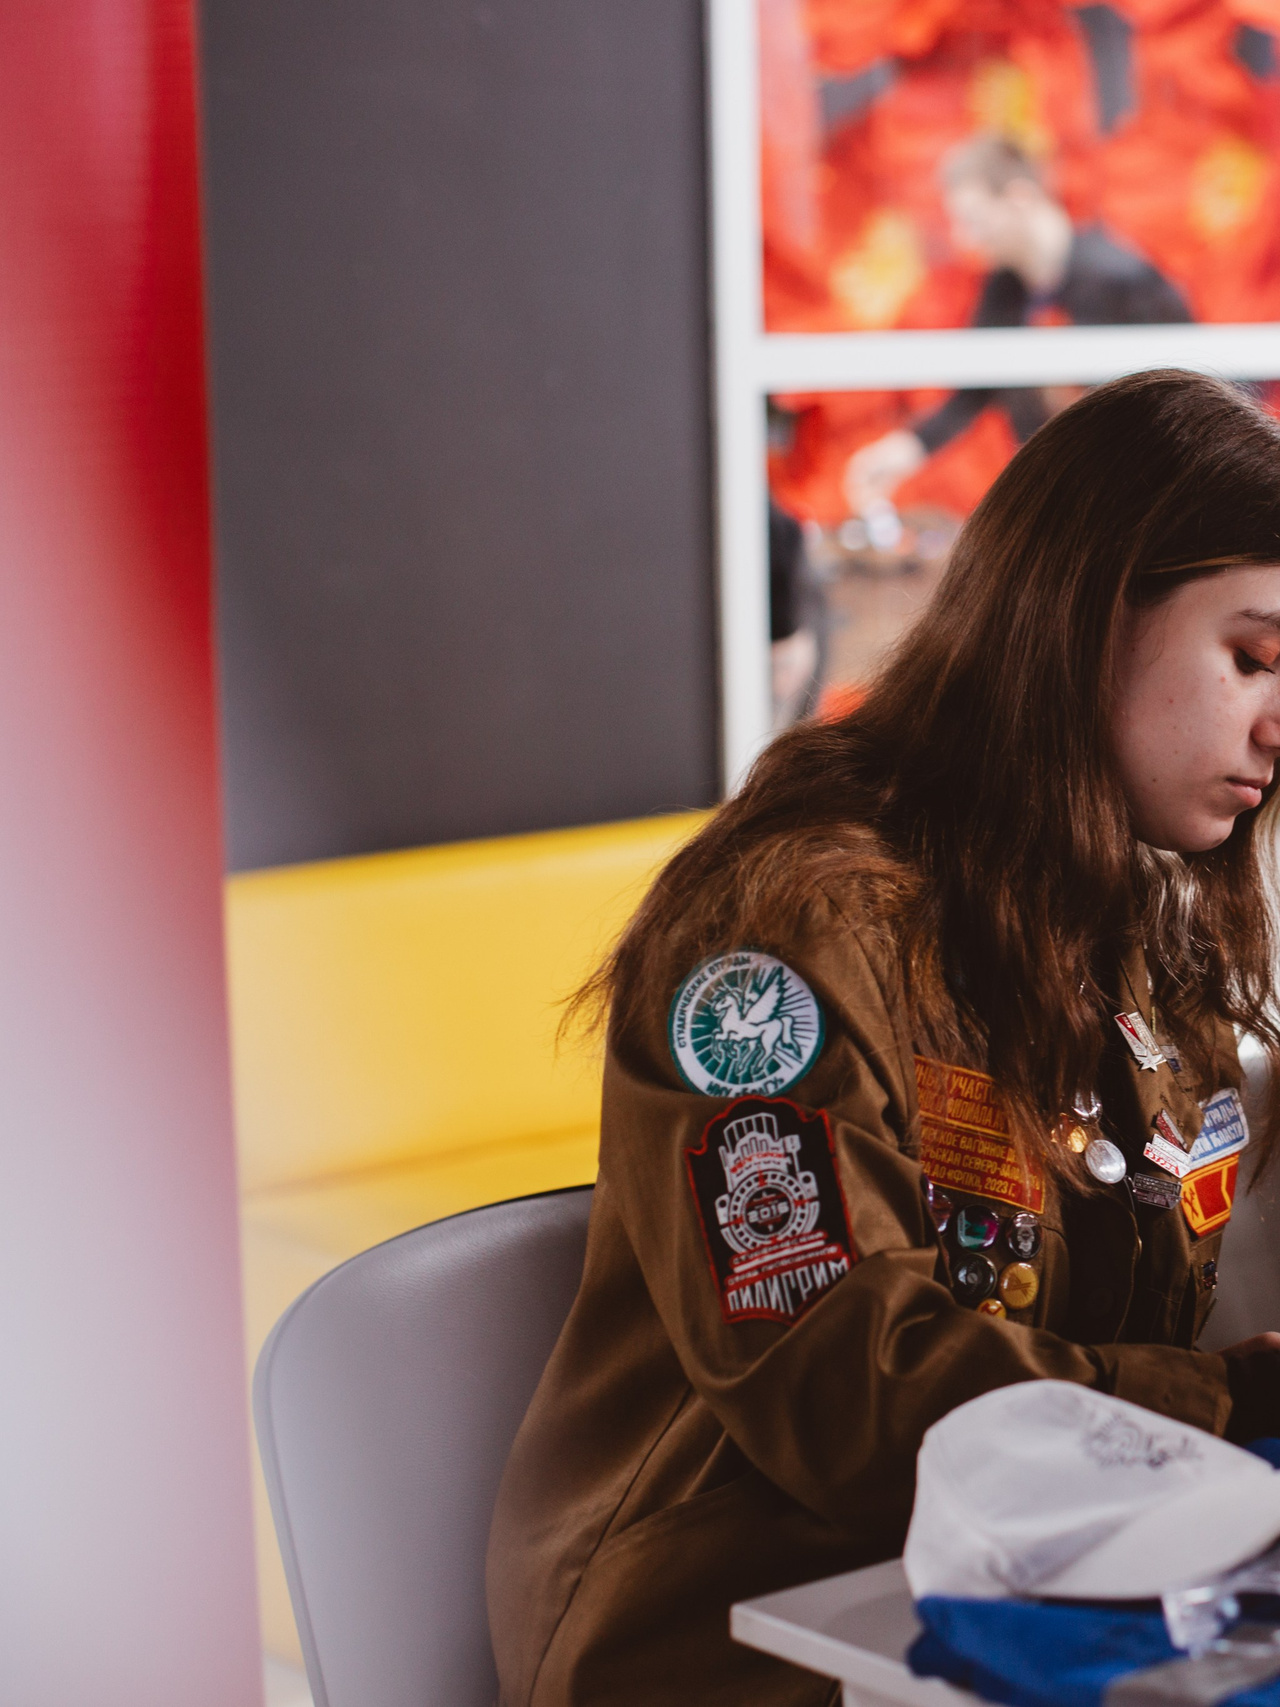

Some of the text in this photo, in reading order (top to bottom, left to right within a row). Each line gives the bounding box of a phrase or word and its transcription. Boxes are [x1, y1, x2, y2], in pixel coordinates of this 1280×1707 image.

[675, 972, 708, 1048] СТУДЕНЧЕСКИЕ
[984, 1176, 1009, 1194] 2023
[727, 1256, 849, 1316] ПИЛИГРИМ
